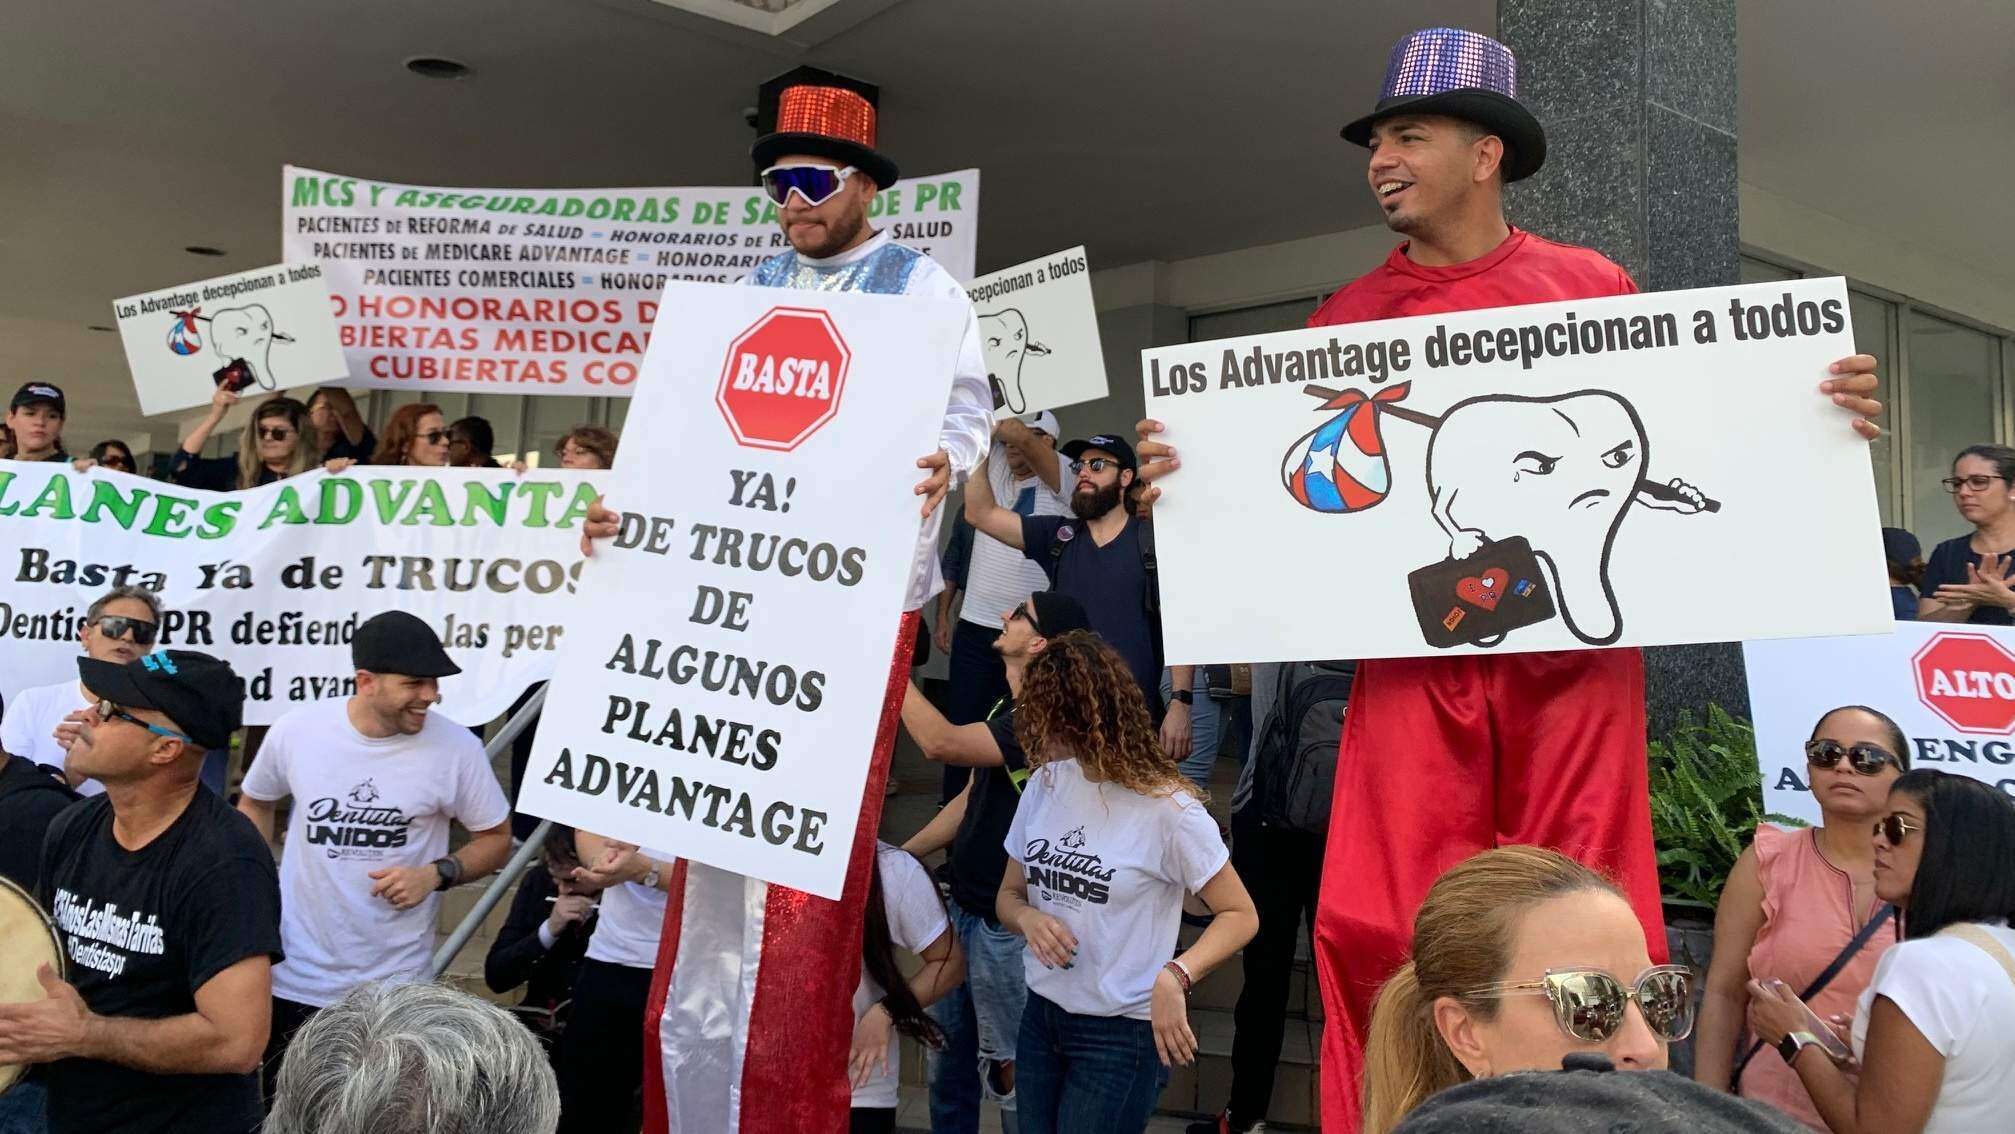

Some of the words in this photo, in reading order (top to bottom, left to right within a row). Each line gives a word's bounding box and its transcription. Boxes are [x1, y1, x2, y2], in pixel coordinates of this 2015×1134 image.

[292, 176, 357, 208] MCS
[370, 184, 386, 207] Y
[394, 189, 680, 225] ASEGURADORAS
[692, 200, 730, 225] DE
[868, 188, 902, 218] DE
[914, 180, 962, 213] PR
[298, 216, 380, 235] PACIENTES
[386, 220, 401, 234] DE
[408, 217, 491, 236] REFORMA
[499, 223, 518, 236] DE
[522, 222, 584, 241] SALUD
[610, 230, 739, 247] HONORARIOS
[744, 236, 763, 248] DE
[892, 221, 953, 240] SALUD
[314, 242, 395, 261] PACIENTES
[402, 246, 419, 261] DE
[425, 243, 512, 262] MEDICARE
[520, 246, 630, 265] ADVANTAGE
[116, 302, 138, 321] Los
[140, 291, 200, 313] Advantage
[202, 275, 275, 302] decepcionan
[278, 273, 286, 285] a
[288, 264, 322, 284] todos
[364, 269, 451, 288] PACIENTES
[459, 271, 575, 290] COMERCIALES
[1037, 268, 1045, 284] a
[1048, 256, 1086, 281] todos
[358, 294, 623, 325] HONORARIOS
[494, 328, 651, 355] MEDICA
[1150, 357, 1208, 397] Los
[1219, 337, 1412, 390] Advantage
[1425, 312, 1679, 370] decepcionan
[1692, 309, 1717, 344] a
[1729, 293, 1845, 341] todos
[370, 354, 567, 384] CUBIERTAS
[732, 353, 831, 400] BASTA
[728, 469, 797, 514] YA!
[15, 547, 167, 593] Basta
[197, 559, 254, 591] Ya
[281, 556, 343, 590] de
[612, 510, 675, 556] DE
[689, 523, 866, 587] TRUCOS
[159, 610, 214, 645] PR
[444, 614, 490, 649] las
[688, 585, 753, 632] DE
[605, 633, 826, 712] ALGUNOS
[1929, 668, 2015, 700] ALTO
[601, 694, 781, 771] PLANES
[544, 747, 828, 856] ADVANTAGE
[306, 824, 408, 848] UNIDOS
